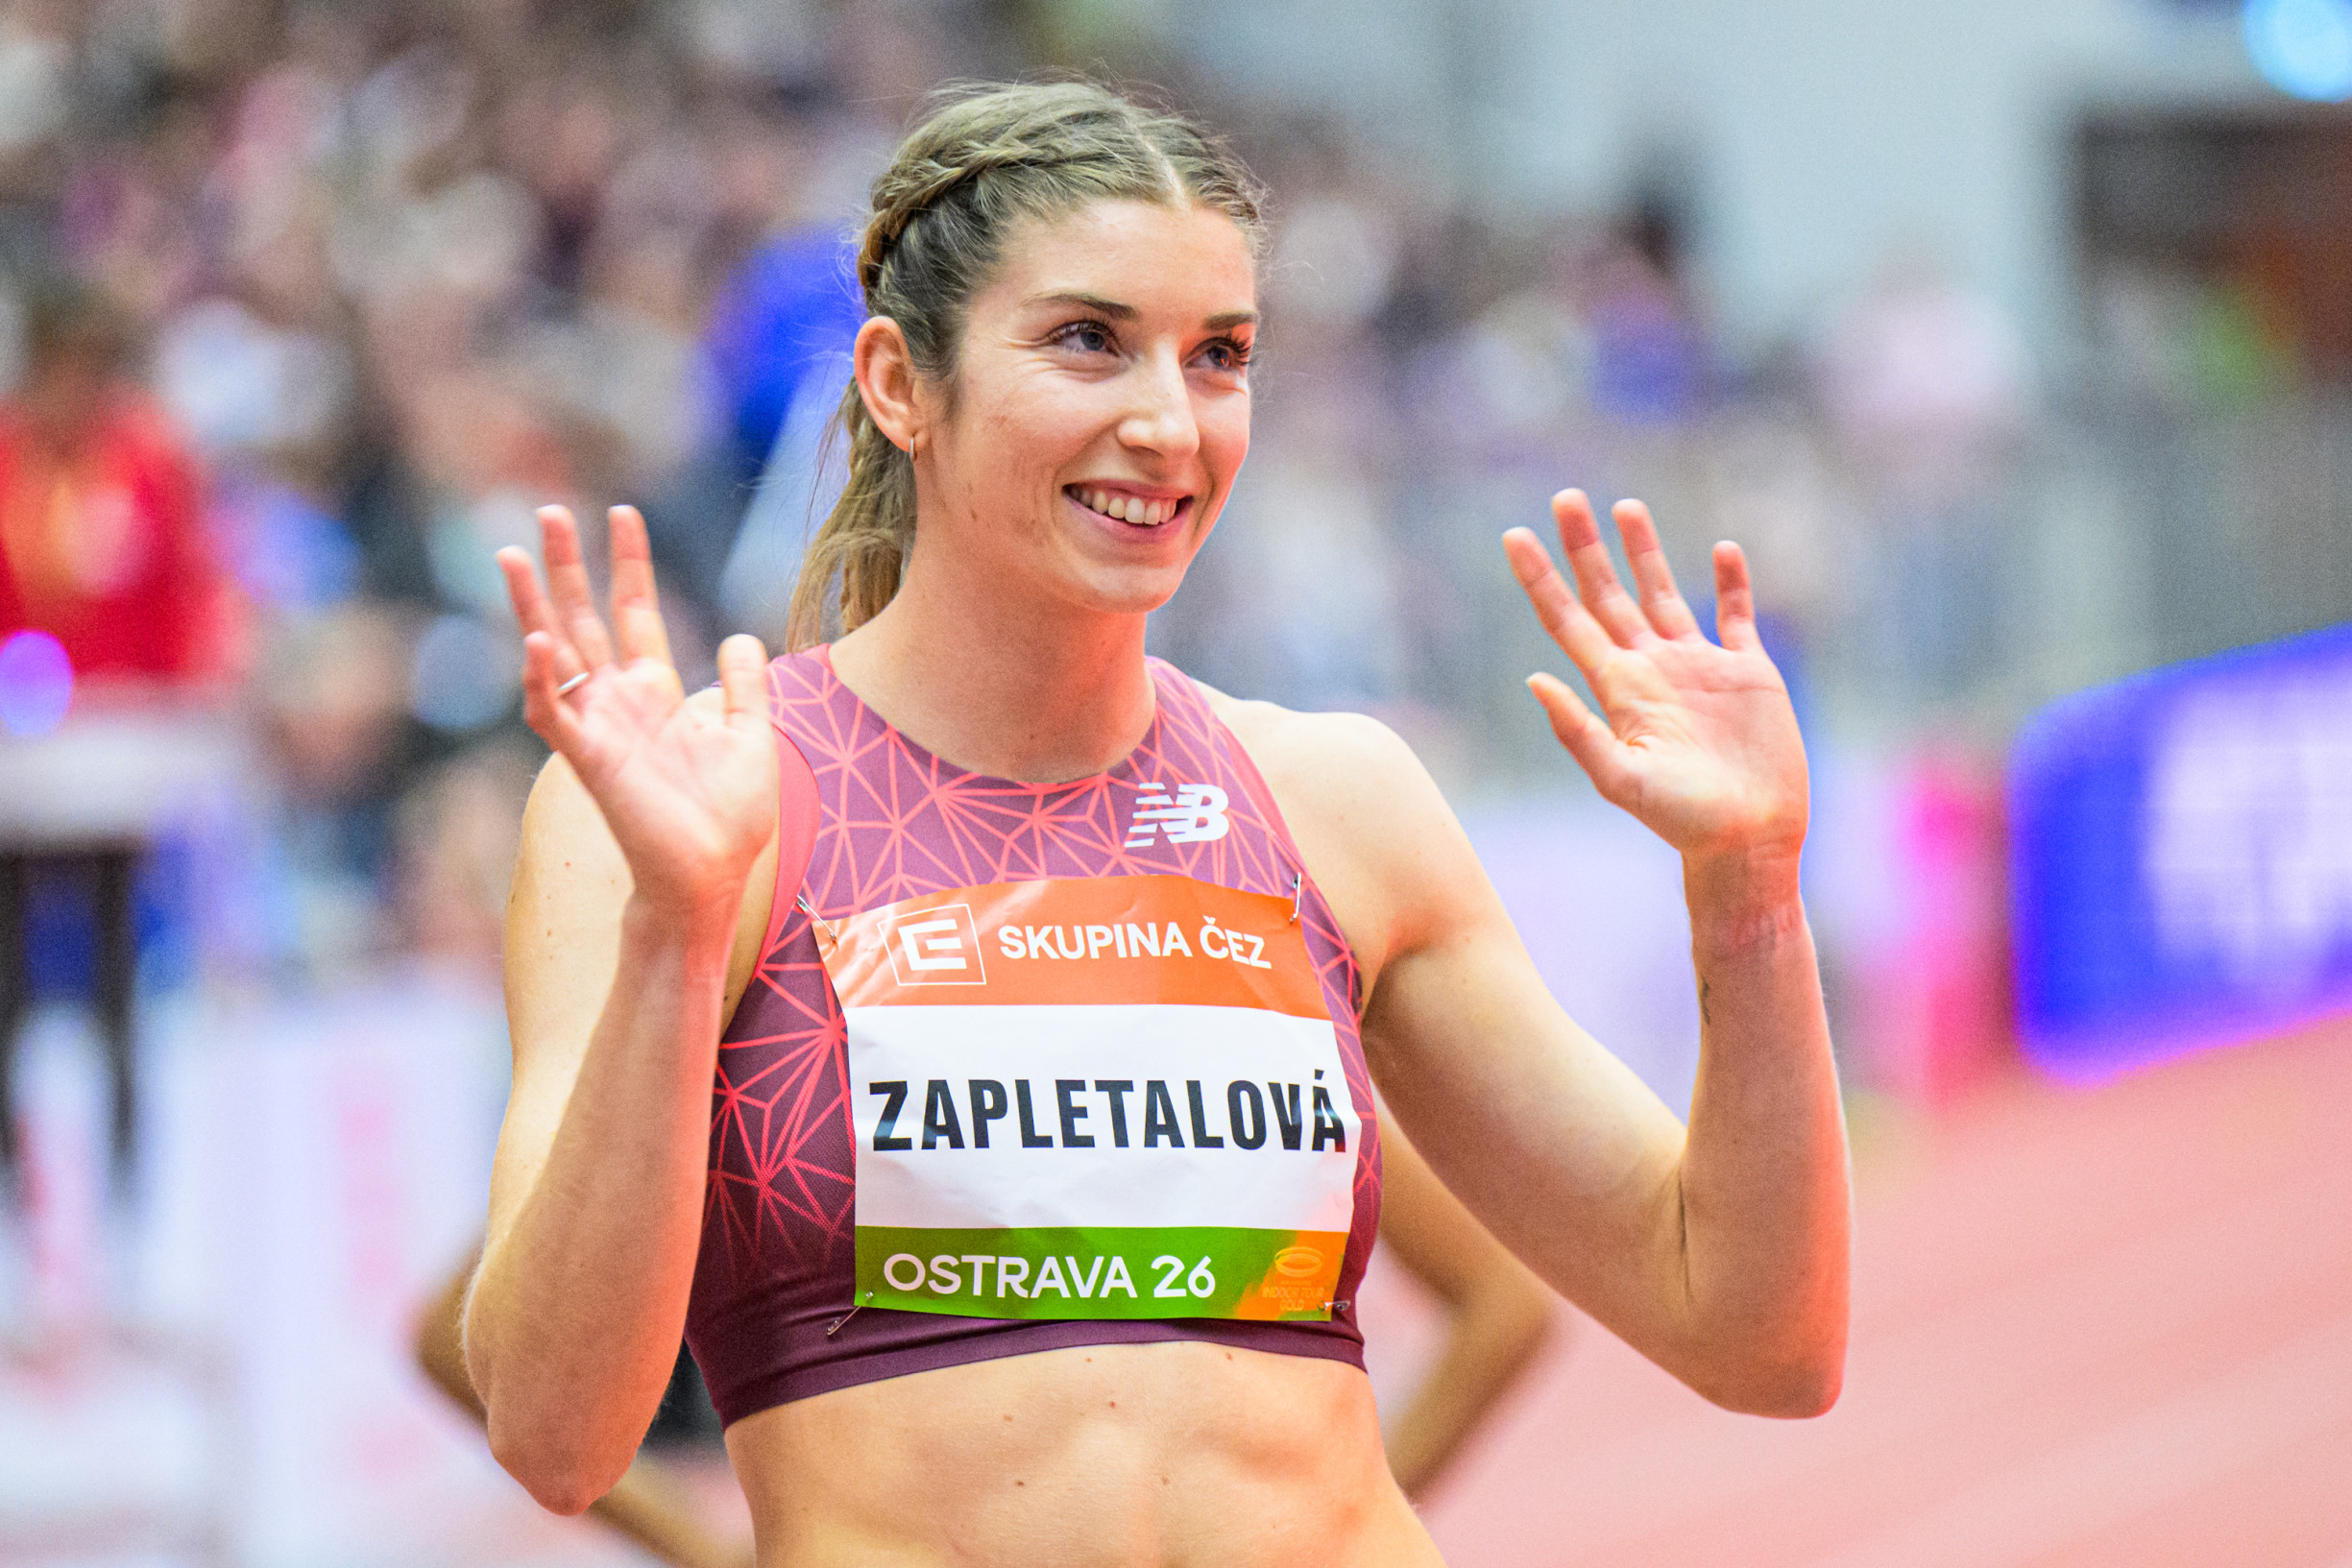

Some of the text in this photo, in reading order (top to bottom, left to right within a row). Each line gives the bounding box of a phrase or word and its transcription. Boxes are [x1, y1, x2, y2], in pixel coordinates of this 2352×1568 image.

[1125, 782, 1229, 848] NB
[998, 915, 1273, 970] SKUPINA ČEZ
[868, 1068, 1346, 1153] ZAPLETALOVÁ
[884, 1252, 1216, 1298] OSTRAVA 26
